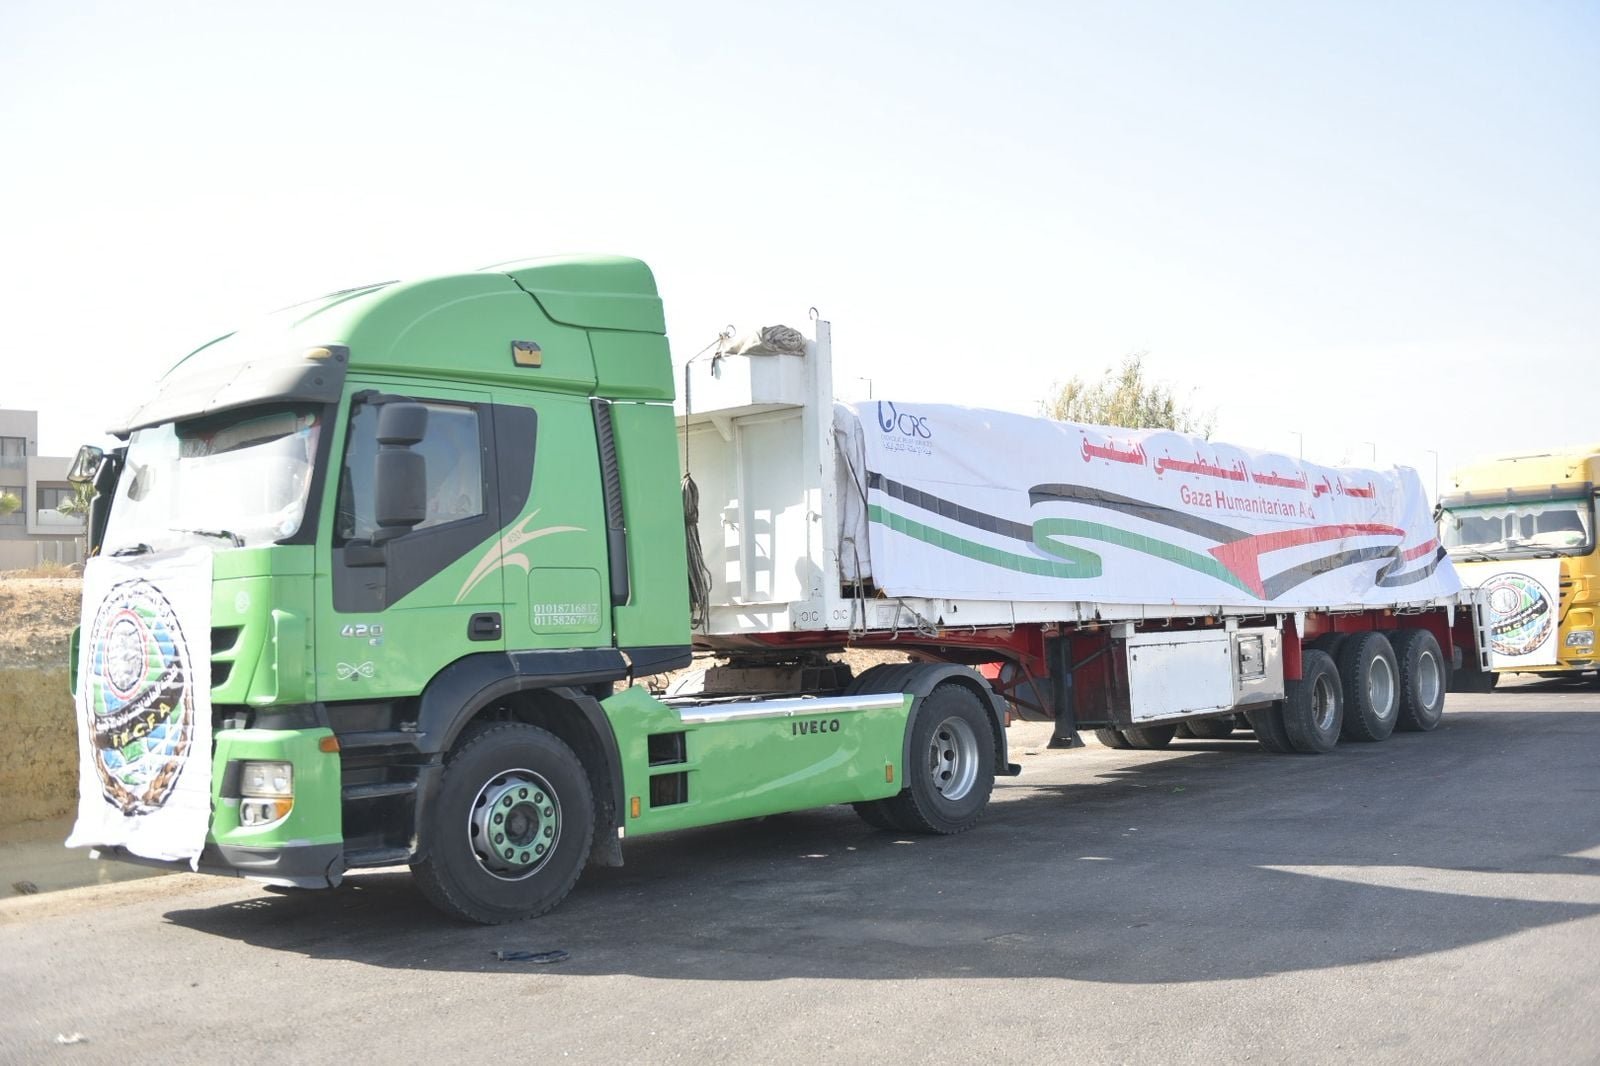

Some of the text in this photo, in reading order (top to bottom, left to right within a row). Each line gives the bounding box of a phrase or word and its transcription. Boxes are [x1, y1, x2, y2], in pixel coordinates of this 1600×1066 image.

[897, 413, 932, 439] CRS
[1079, 429, 1148, 467] الشقيق
[1153, 448, 1250, 482] الفلسطيني
[1180, 484, 1213, 508] Gaza
[1214, 489, 1297, 517] Humanitarian
[341, 624, 384, 638] 420
[792, 718, 840, 736] IVECO
